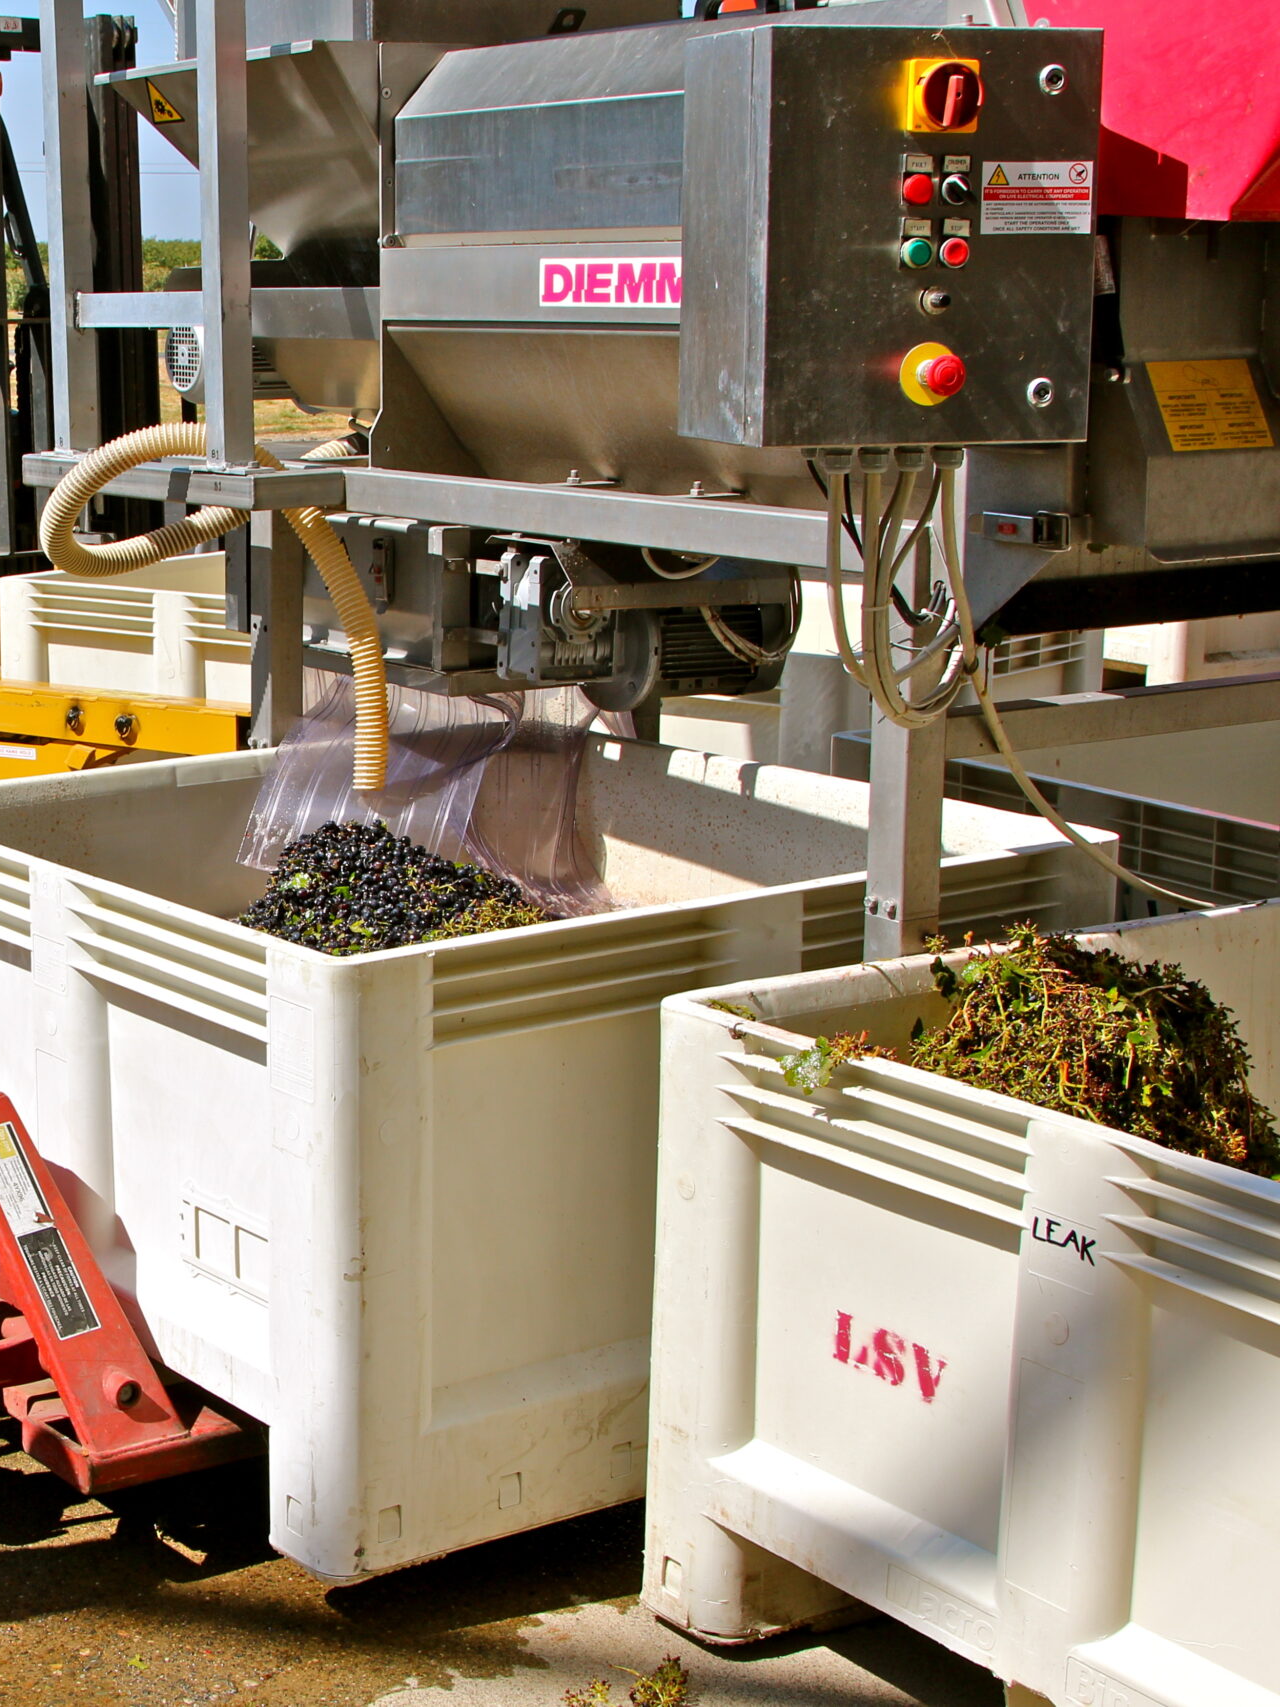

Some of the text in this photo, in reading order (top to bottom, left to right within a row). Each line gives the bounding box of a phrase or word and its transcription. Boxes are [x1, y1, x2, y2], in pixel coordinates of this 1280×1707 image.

[1032, 1216, 1096, 1267] LEAK
[66, 1265, 79, 1287] CAUTION
[832, 1309, 949, 1404] LSV
